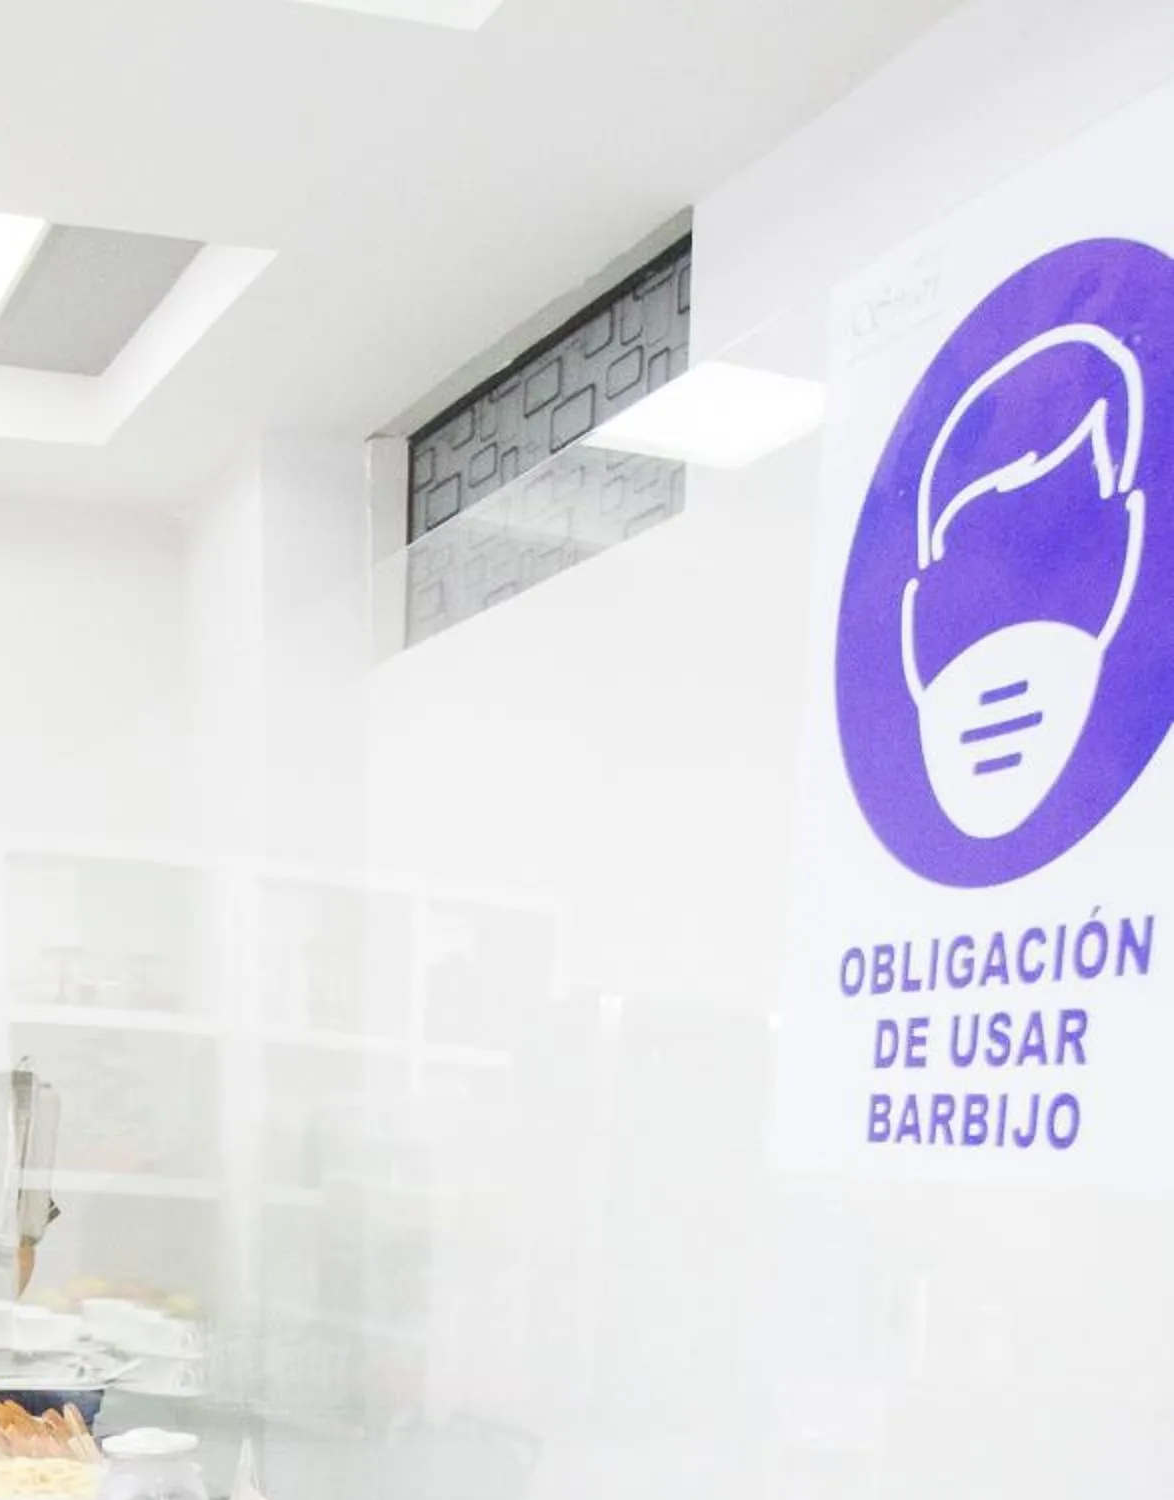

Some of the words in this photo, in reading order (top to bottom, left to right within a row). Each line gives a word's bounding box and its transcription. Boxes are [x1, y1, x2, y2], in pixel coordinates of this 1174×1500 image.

[840, 905, 1154, 997] OBLIGACIÓN
[874, 1017, 929, 1068] DE
[949, 1008, 1088, 1067] USAR
[867, 1093, 1081, 1150] BARBIJO
